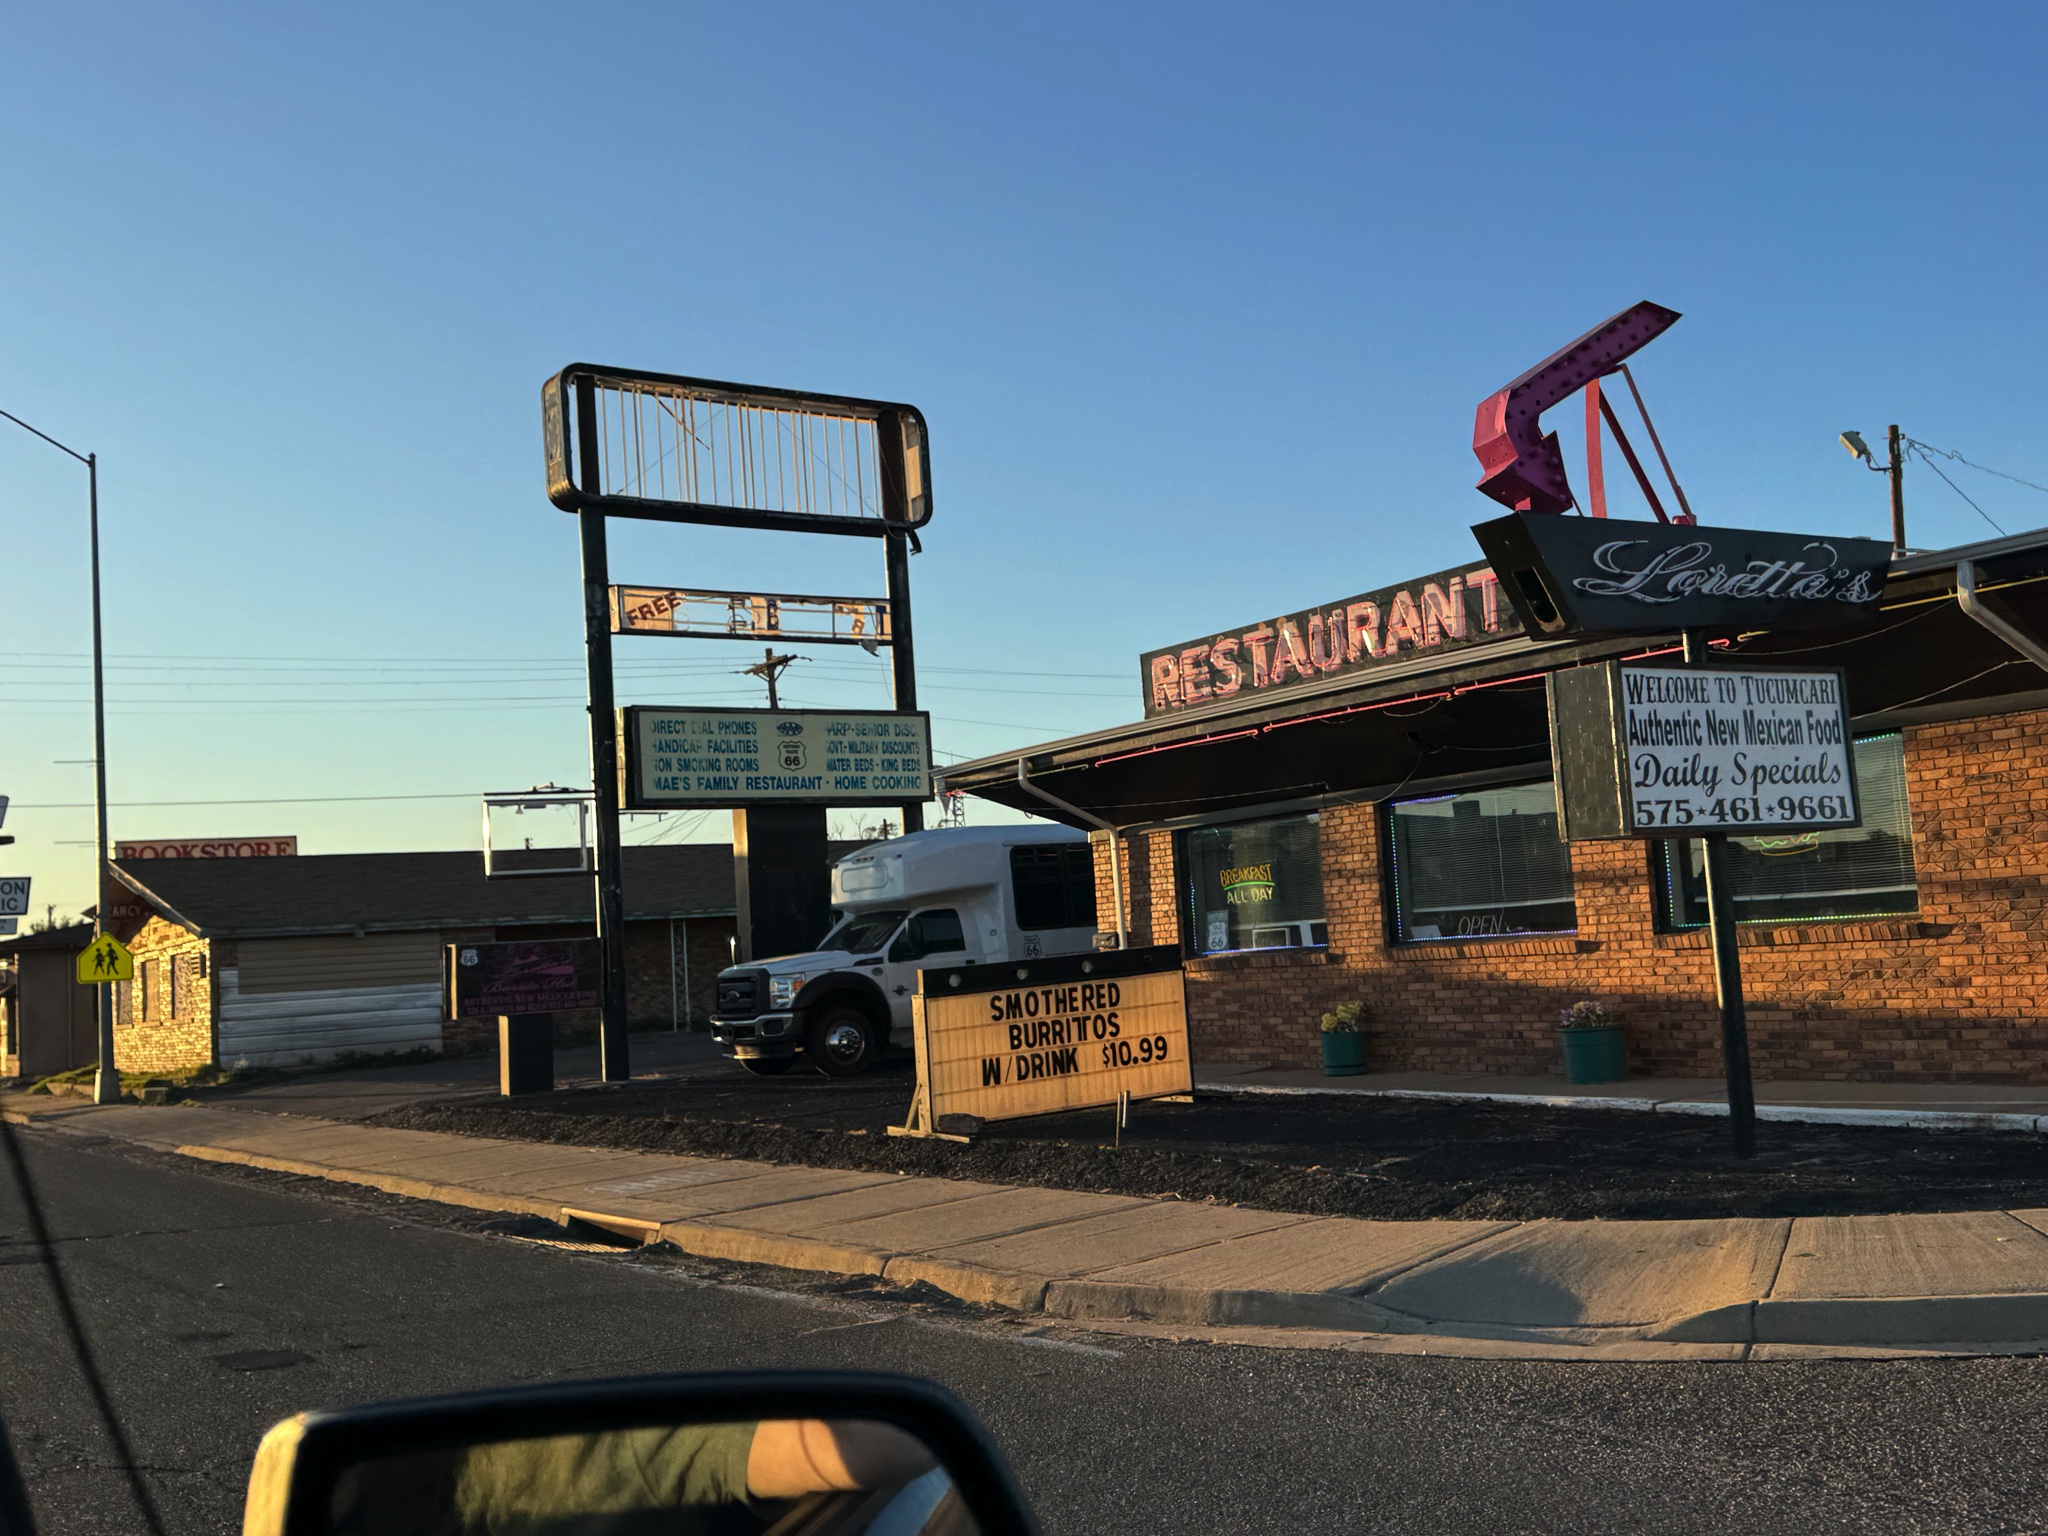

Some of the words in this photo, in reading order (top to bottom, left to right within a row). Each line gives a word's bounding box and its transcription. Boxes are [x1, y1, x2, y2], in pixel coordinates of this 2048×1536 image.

[1573, 540, 1882, 603] Loretta's
[626, 590, 684, 625] FREE
[1150, 566, 1500, 711] RESTAURANT
[1624, 673, 1709, 705] WELCOME
[1714, 676, 1736, 704] TO
[1740, 675, 1838, 705] TUCUMCARI
[718, 720, 757, 735] PHONES
[1629, 709, 1702, 747] Authentic
[1706, 709, 1740, 746] New
[1743, 709, 1803, 746] Mexican
[1806, 709, 1842, 745] Food
[707, 739, 759, 754] FACILITIES
[677, 757, 725, 772] SMOKING
[726, 757, 759, 772] ROOMS
[784, 756, 800, 766] 66
[826, 758, 851, 771] WATER
[854, 758, 874, 772] BEDS
[902, 759, 921, 772] BEDS
[697, 776, 739, 791] FAMILY
[746, 775, 822, 790] RESTAURANT
[834, 776, 867, 790] HOME
[872, 775, 922, 790] COOKING
[1635, 753, 1722, 797] Daily
[1731, 752, 1841, 796] Specials
[121, 841, 293, 858] BOOKSTORE
[1220, 864, 1272, 887] BREAKFAST
[1227, 890, 1245, 904] ALL
[1252, 887, 1273, 901] DAY
[1458, 915, 1503, 935] OPEN
[1026, 945, 1039, 956] 66
[1211, 936, 1224, 948] 66
[463, 954, 476, 964] 66
[990, 982, 1121, 1022] SMOTHERED
[1102, 1036, 1168, 1069] $10.99
